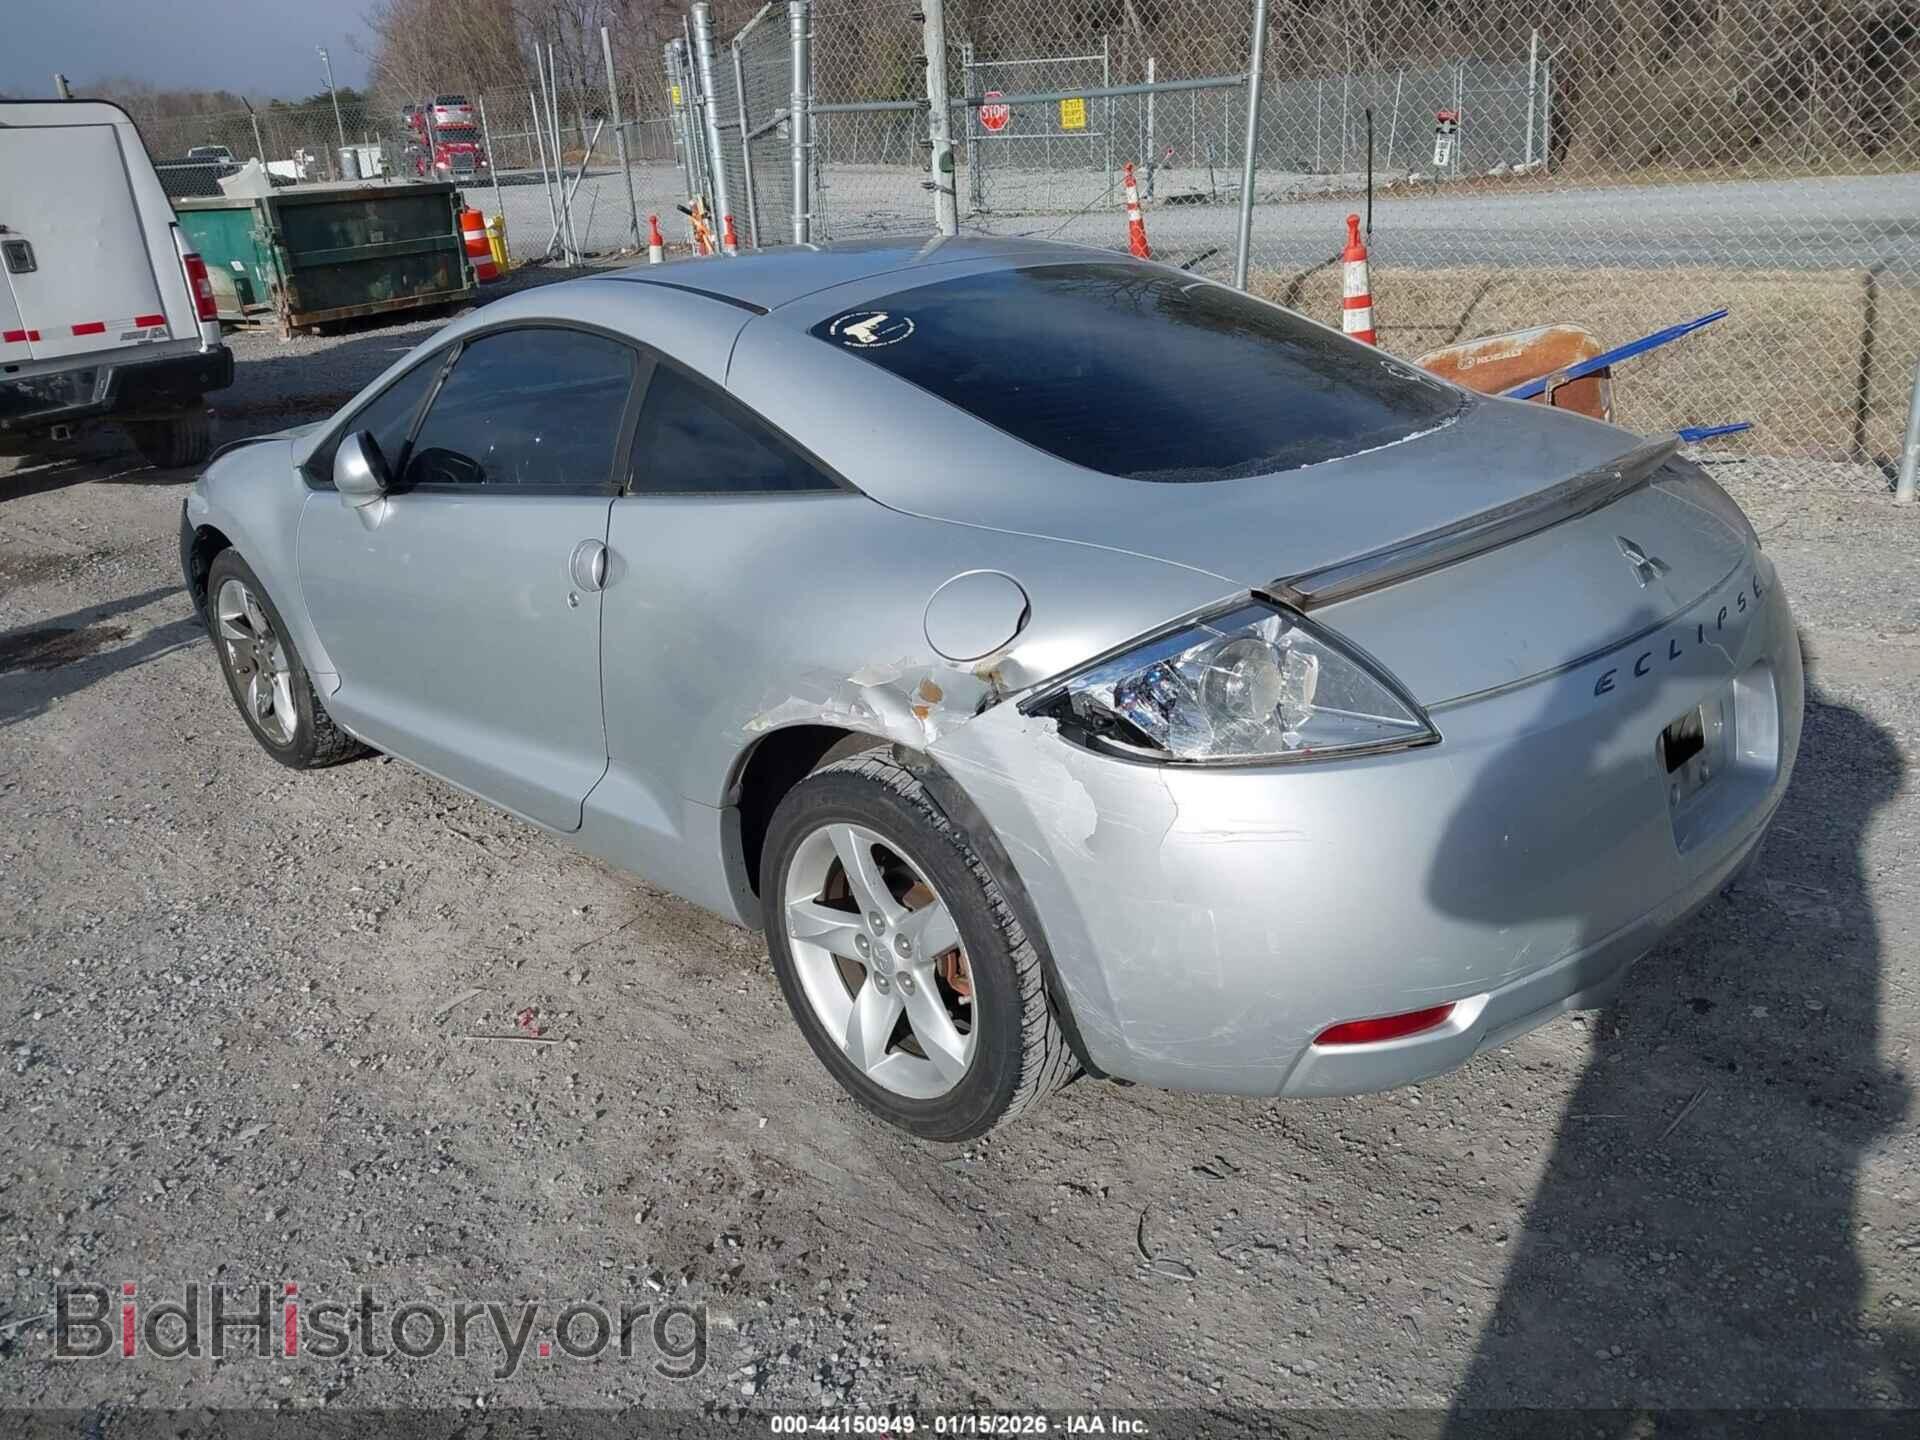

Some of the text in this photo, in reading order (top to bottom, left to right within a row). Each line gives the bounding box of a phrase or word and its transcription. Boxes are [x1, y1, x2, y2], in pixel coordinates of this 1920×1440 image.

[982, 104, 1007, 119] STOP
[1438, 150, 1445, 163] 5
[1593, 575, 1763, 697] ECLIPSE
